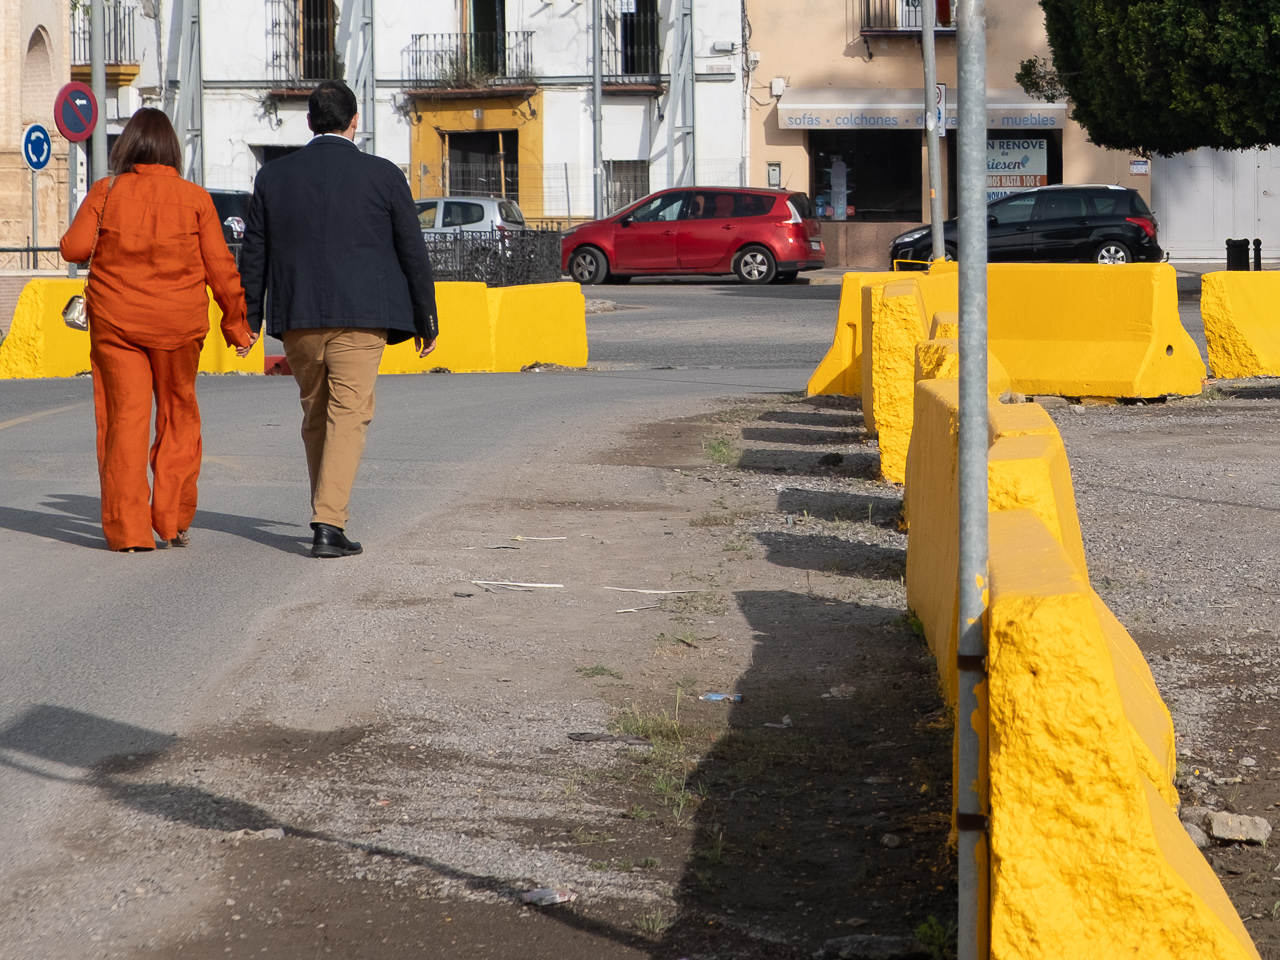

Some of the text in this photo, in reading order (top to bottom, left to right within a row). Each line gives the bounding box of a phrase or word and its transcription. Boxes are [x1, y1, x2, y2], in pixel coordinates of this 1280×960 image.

[787, 112, 1056, 126] sofás colchones muebles
[998, 140, 1045, 150] RENOVE
[1001, 175, 1021, 187] HASTA
[1023, 175, 1035, 187] 100
